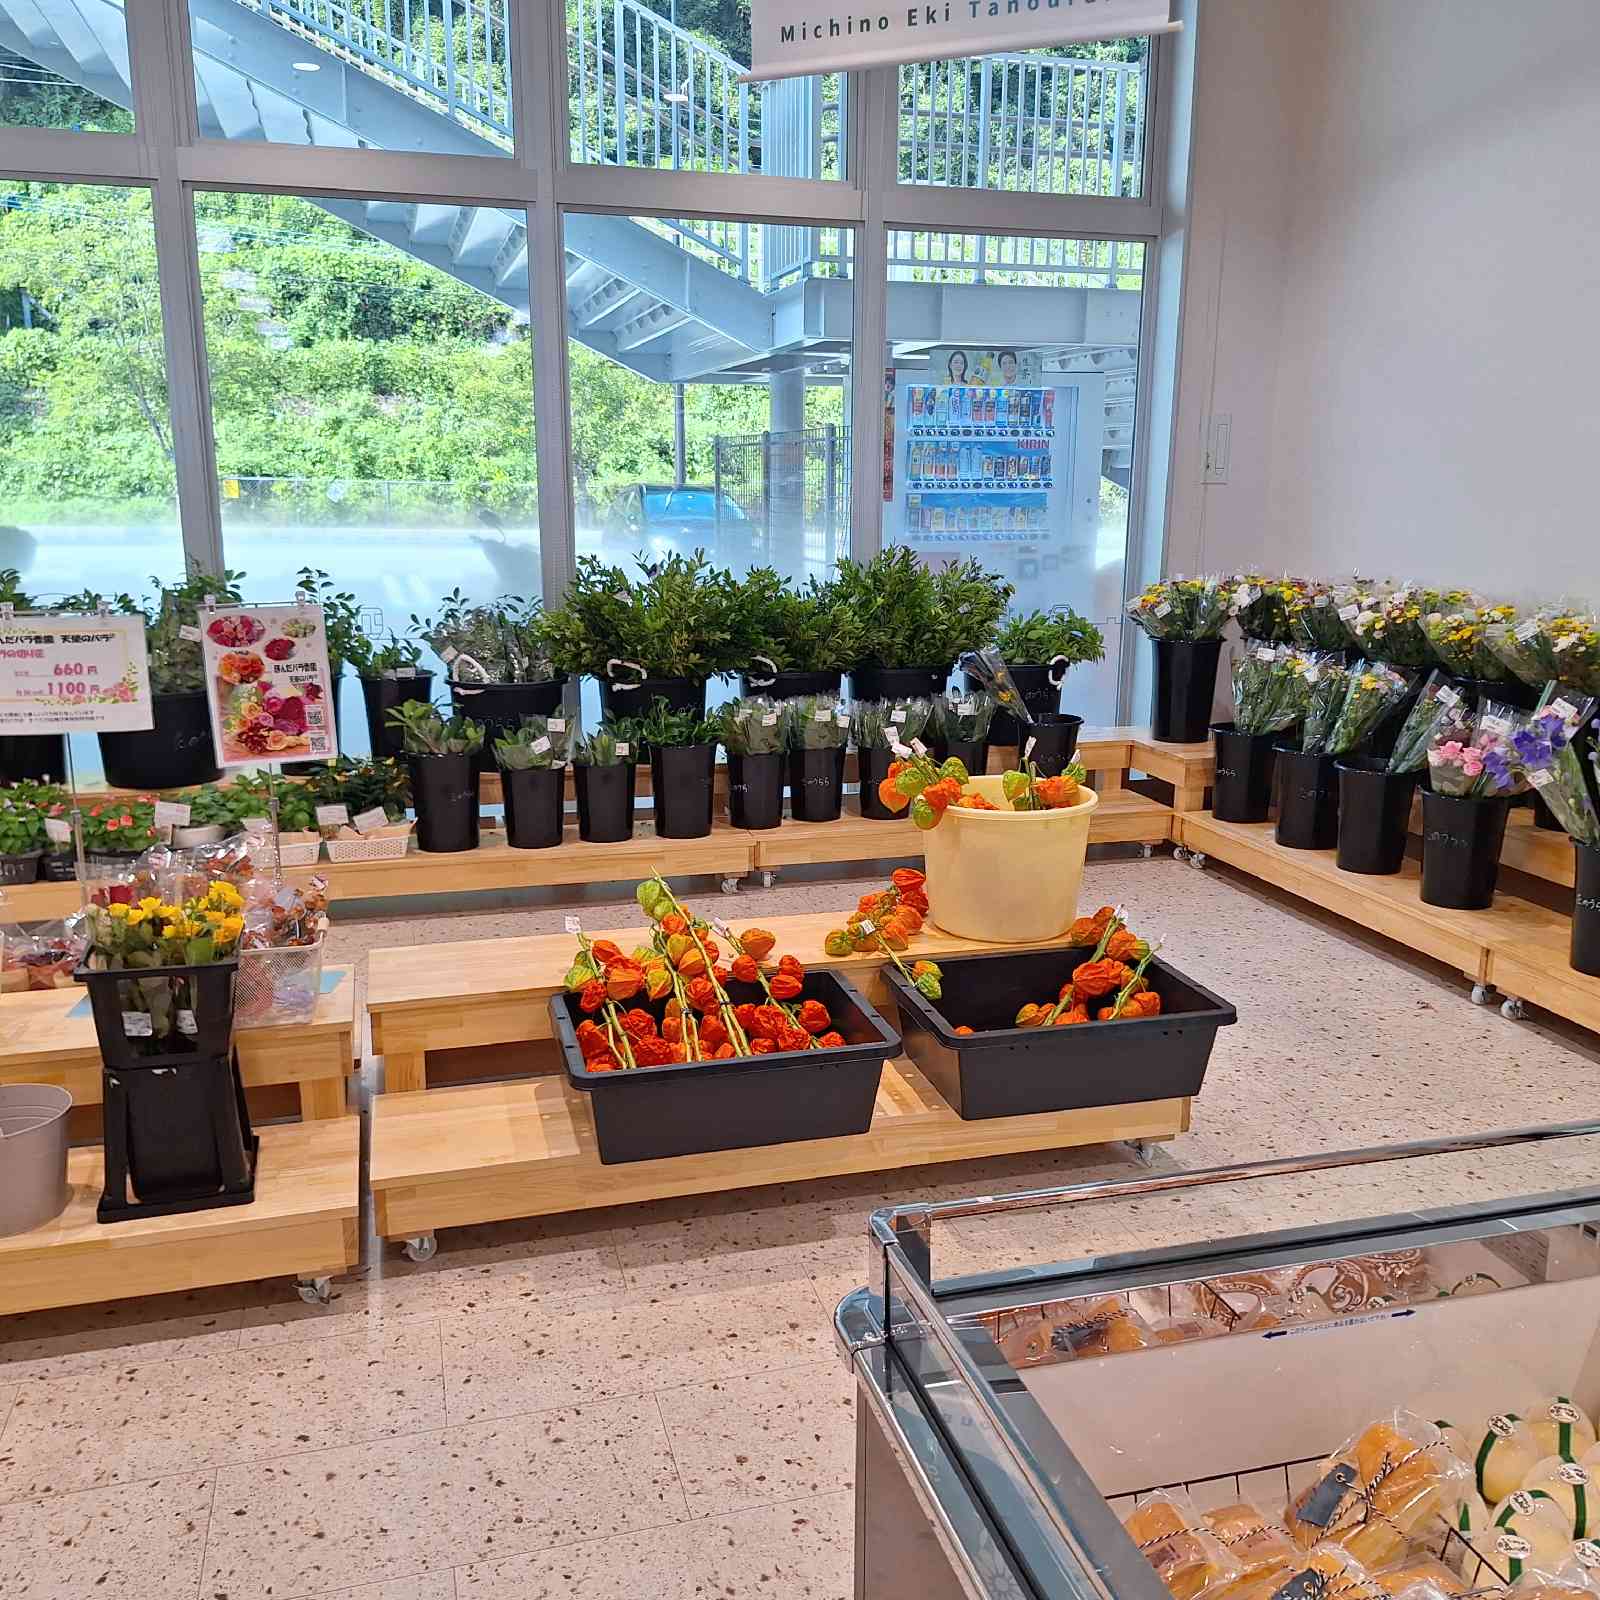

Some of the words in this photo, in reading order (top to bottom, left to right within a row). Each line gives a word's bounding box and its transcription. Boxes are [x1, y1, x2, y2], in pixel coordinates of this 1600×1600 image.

[780, 13, 889, 43] Michino
[907, 3, 952, 27] Eki
[969, 0, 1112, 18] Tanou
[1017, 439, 1050, 449] KIRIN
